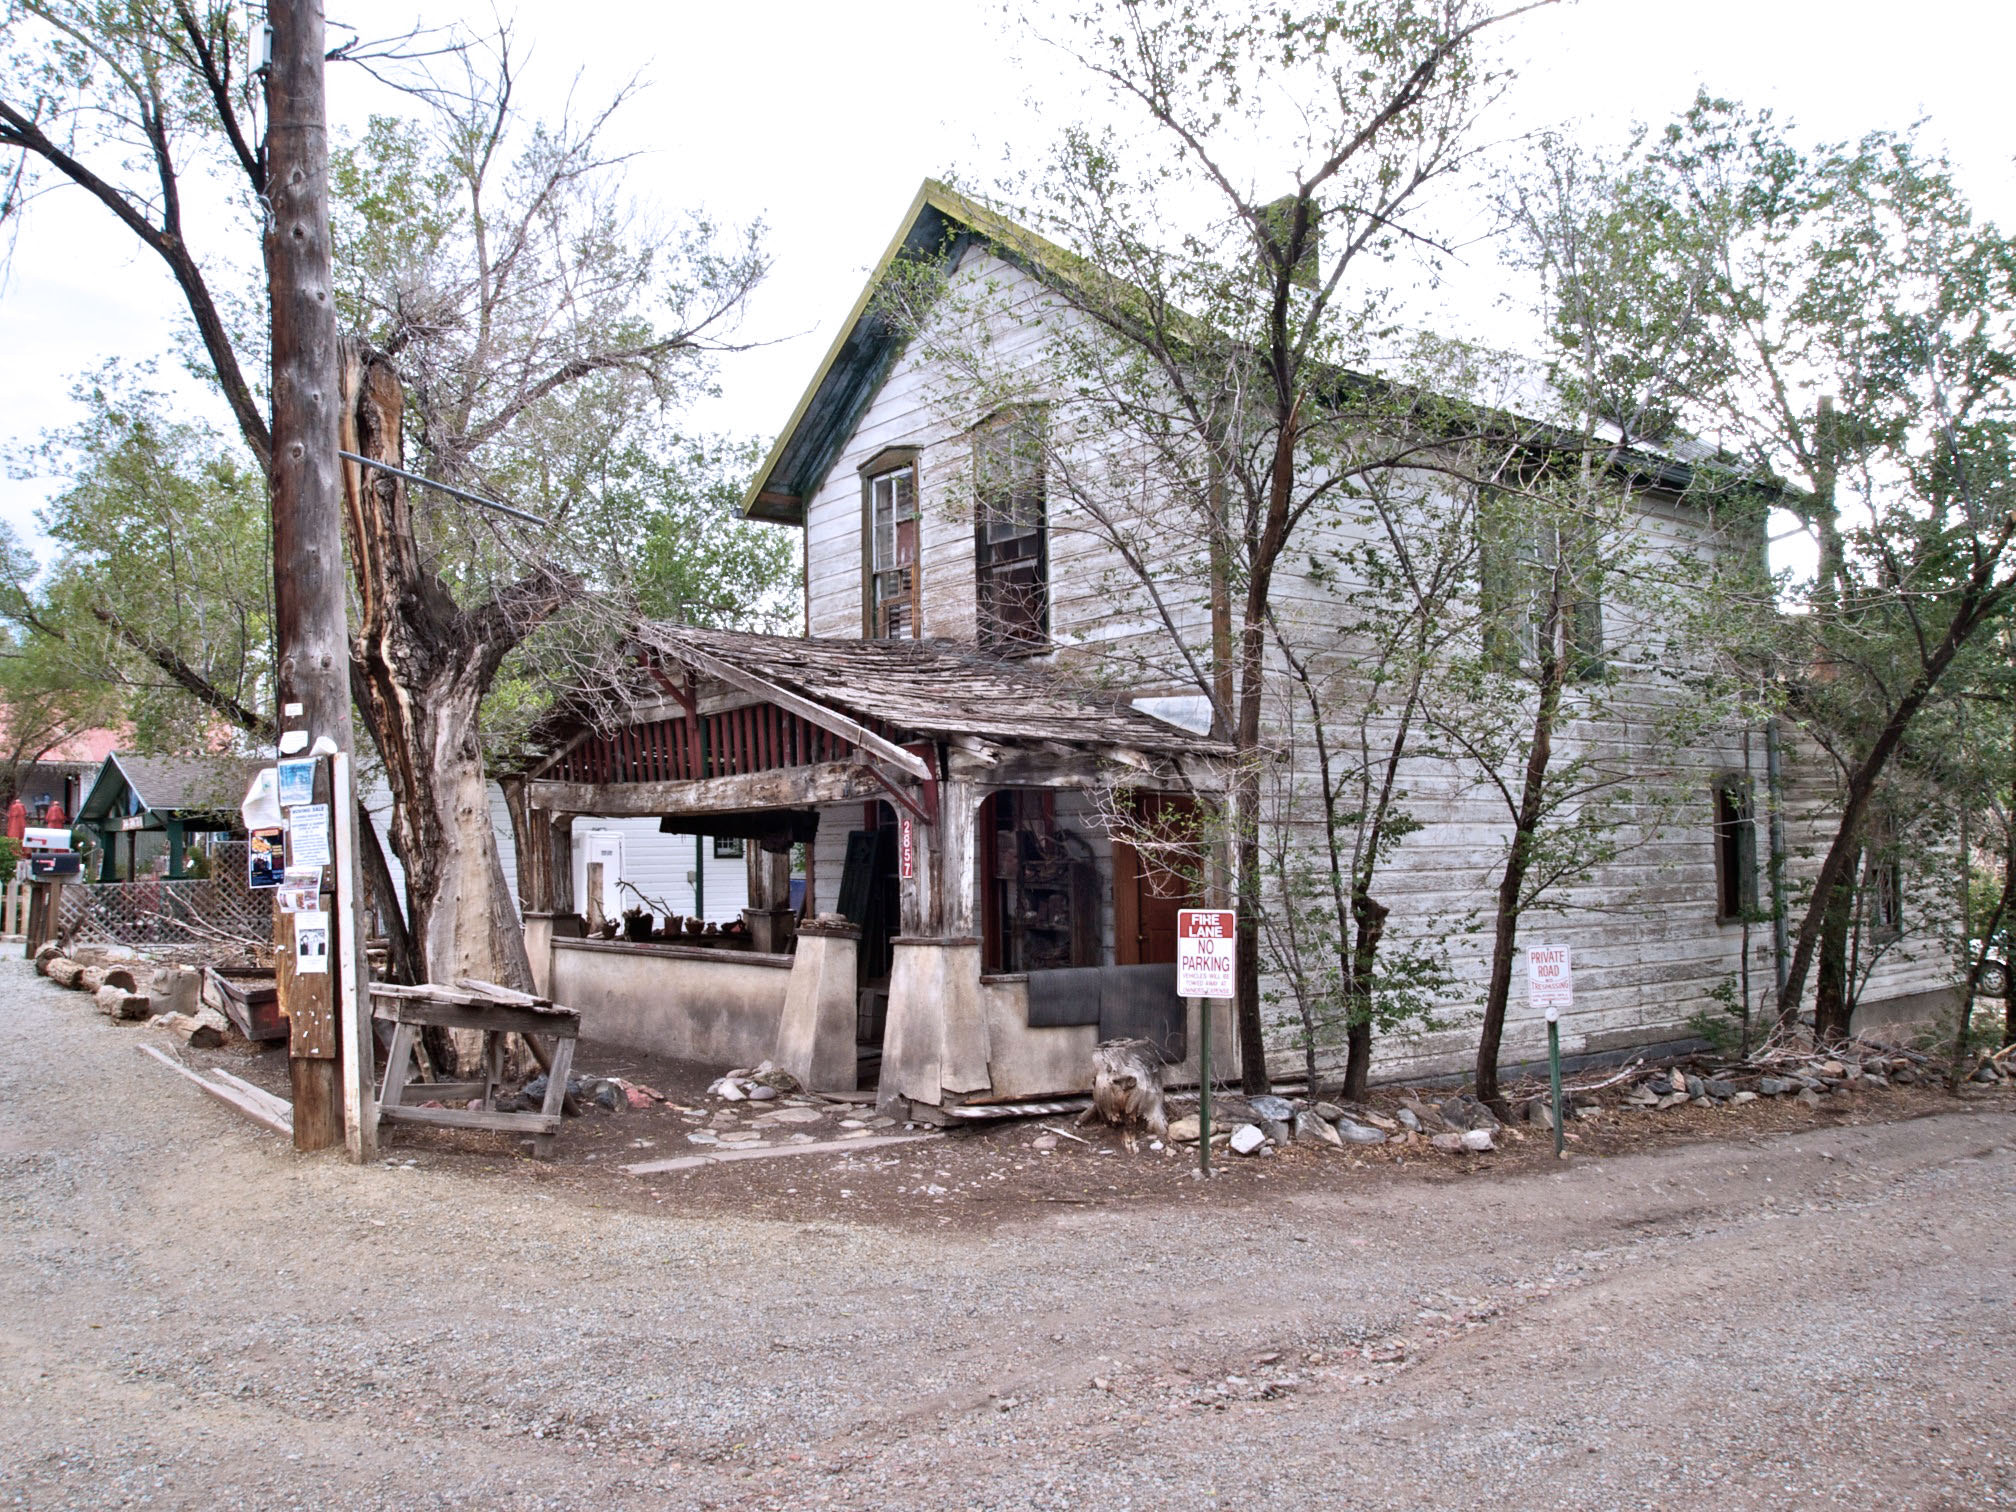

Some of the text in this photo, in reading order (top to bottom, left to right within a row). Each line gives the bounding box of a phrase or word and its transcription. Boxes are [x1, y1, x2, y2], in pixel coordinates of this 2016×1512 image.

[903, 820, 911, 876] 2857
[1191, 914, 1220, 926] FIRE
[1188, 926, 1223, 938] LANE
[1198, 939, 1214, 955] NO
[1531, 951, 1565, 964] PRIVATE
[1182, 956, 1230, 972] PARKING
[1538, 965, 1560, 976] ROAD
[1531, 981, 1569, 990] TRESPASSING
